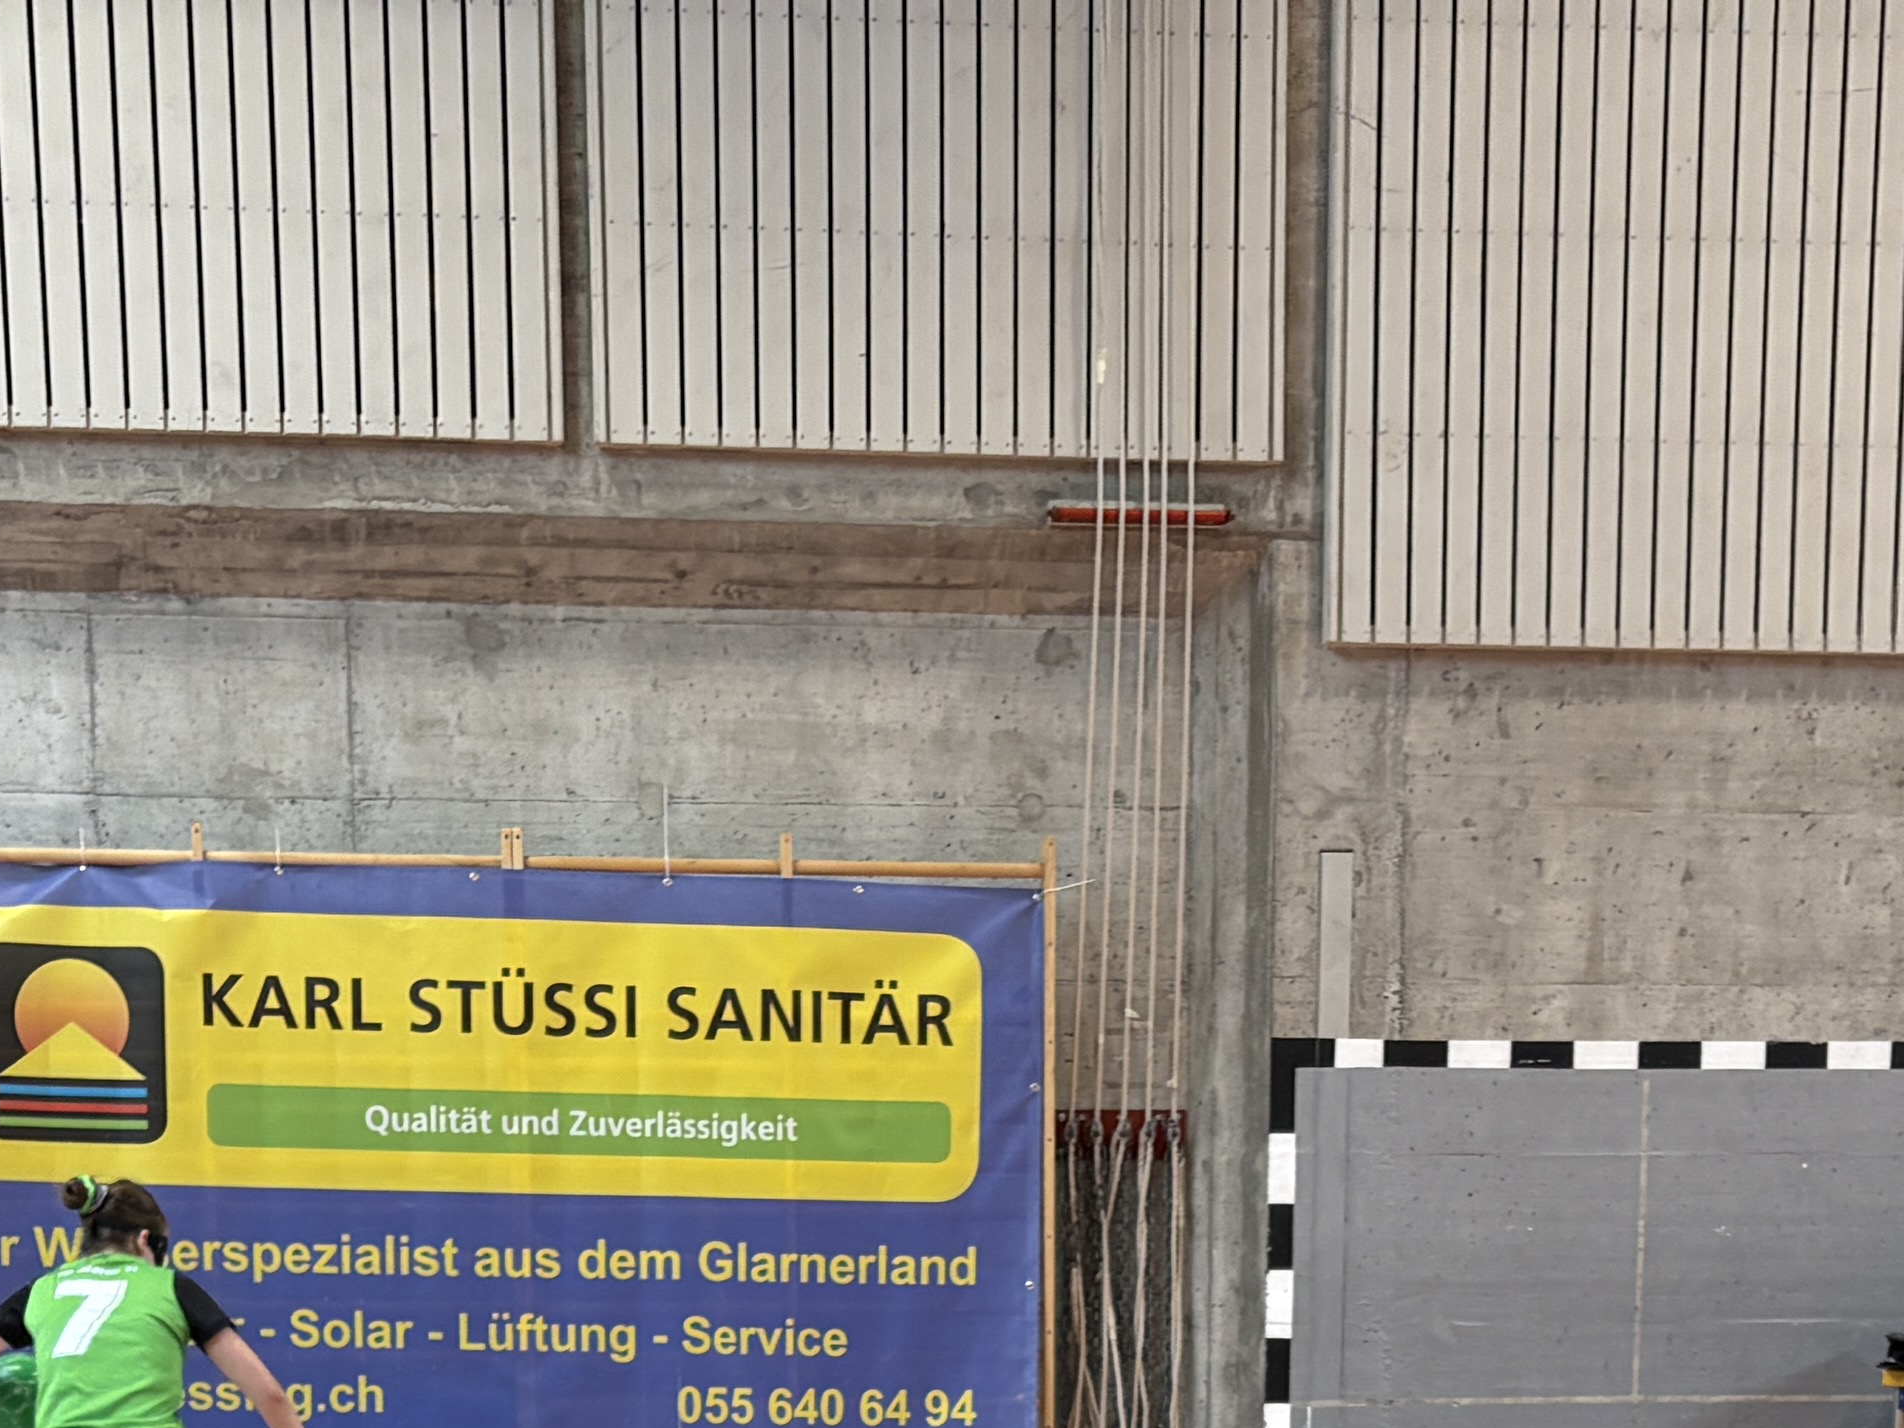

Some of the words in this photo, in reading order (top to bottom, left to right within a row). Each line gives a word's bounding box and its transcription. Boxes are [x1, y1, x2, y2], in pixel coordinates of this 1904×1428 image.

[201, 972, 383, 1033] KARL
[409, 967, 638, 1039] STÜSSI
[667, 979, 954, 1047] SANITÄR
[363, 1104, 493, 1137] Qualität
[500, 1107, 560, 1137] und
[568, 1109, 799, 1147] Zuverlässigkeit
[33, 1226, 460, 1283] Werspezialist
[474, 1247, 561, 1279] aus
[577, 1239, 682, 1281] dem
[698, 1241, 978, 1287] Glarnerland
[51, 1279, 129, 1359] 7
[289, 1309, 414, 1350] Solar
[458, 1312, 637, 1363] Lüftung
[682, 1315, 849, 1357] Service
[678, 1386, 755, 1425] 055
[767, 1387, 845, 1426] 640
[859, 1388, 911, 1427] 64
[925, 1388, 978, 1427] 94
